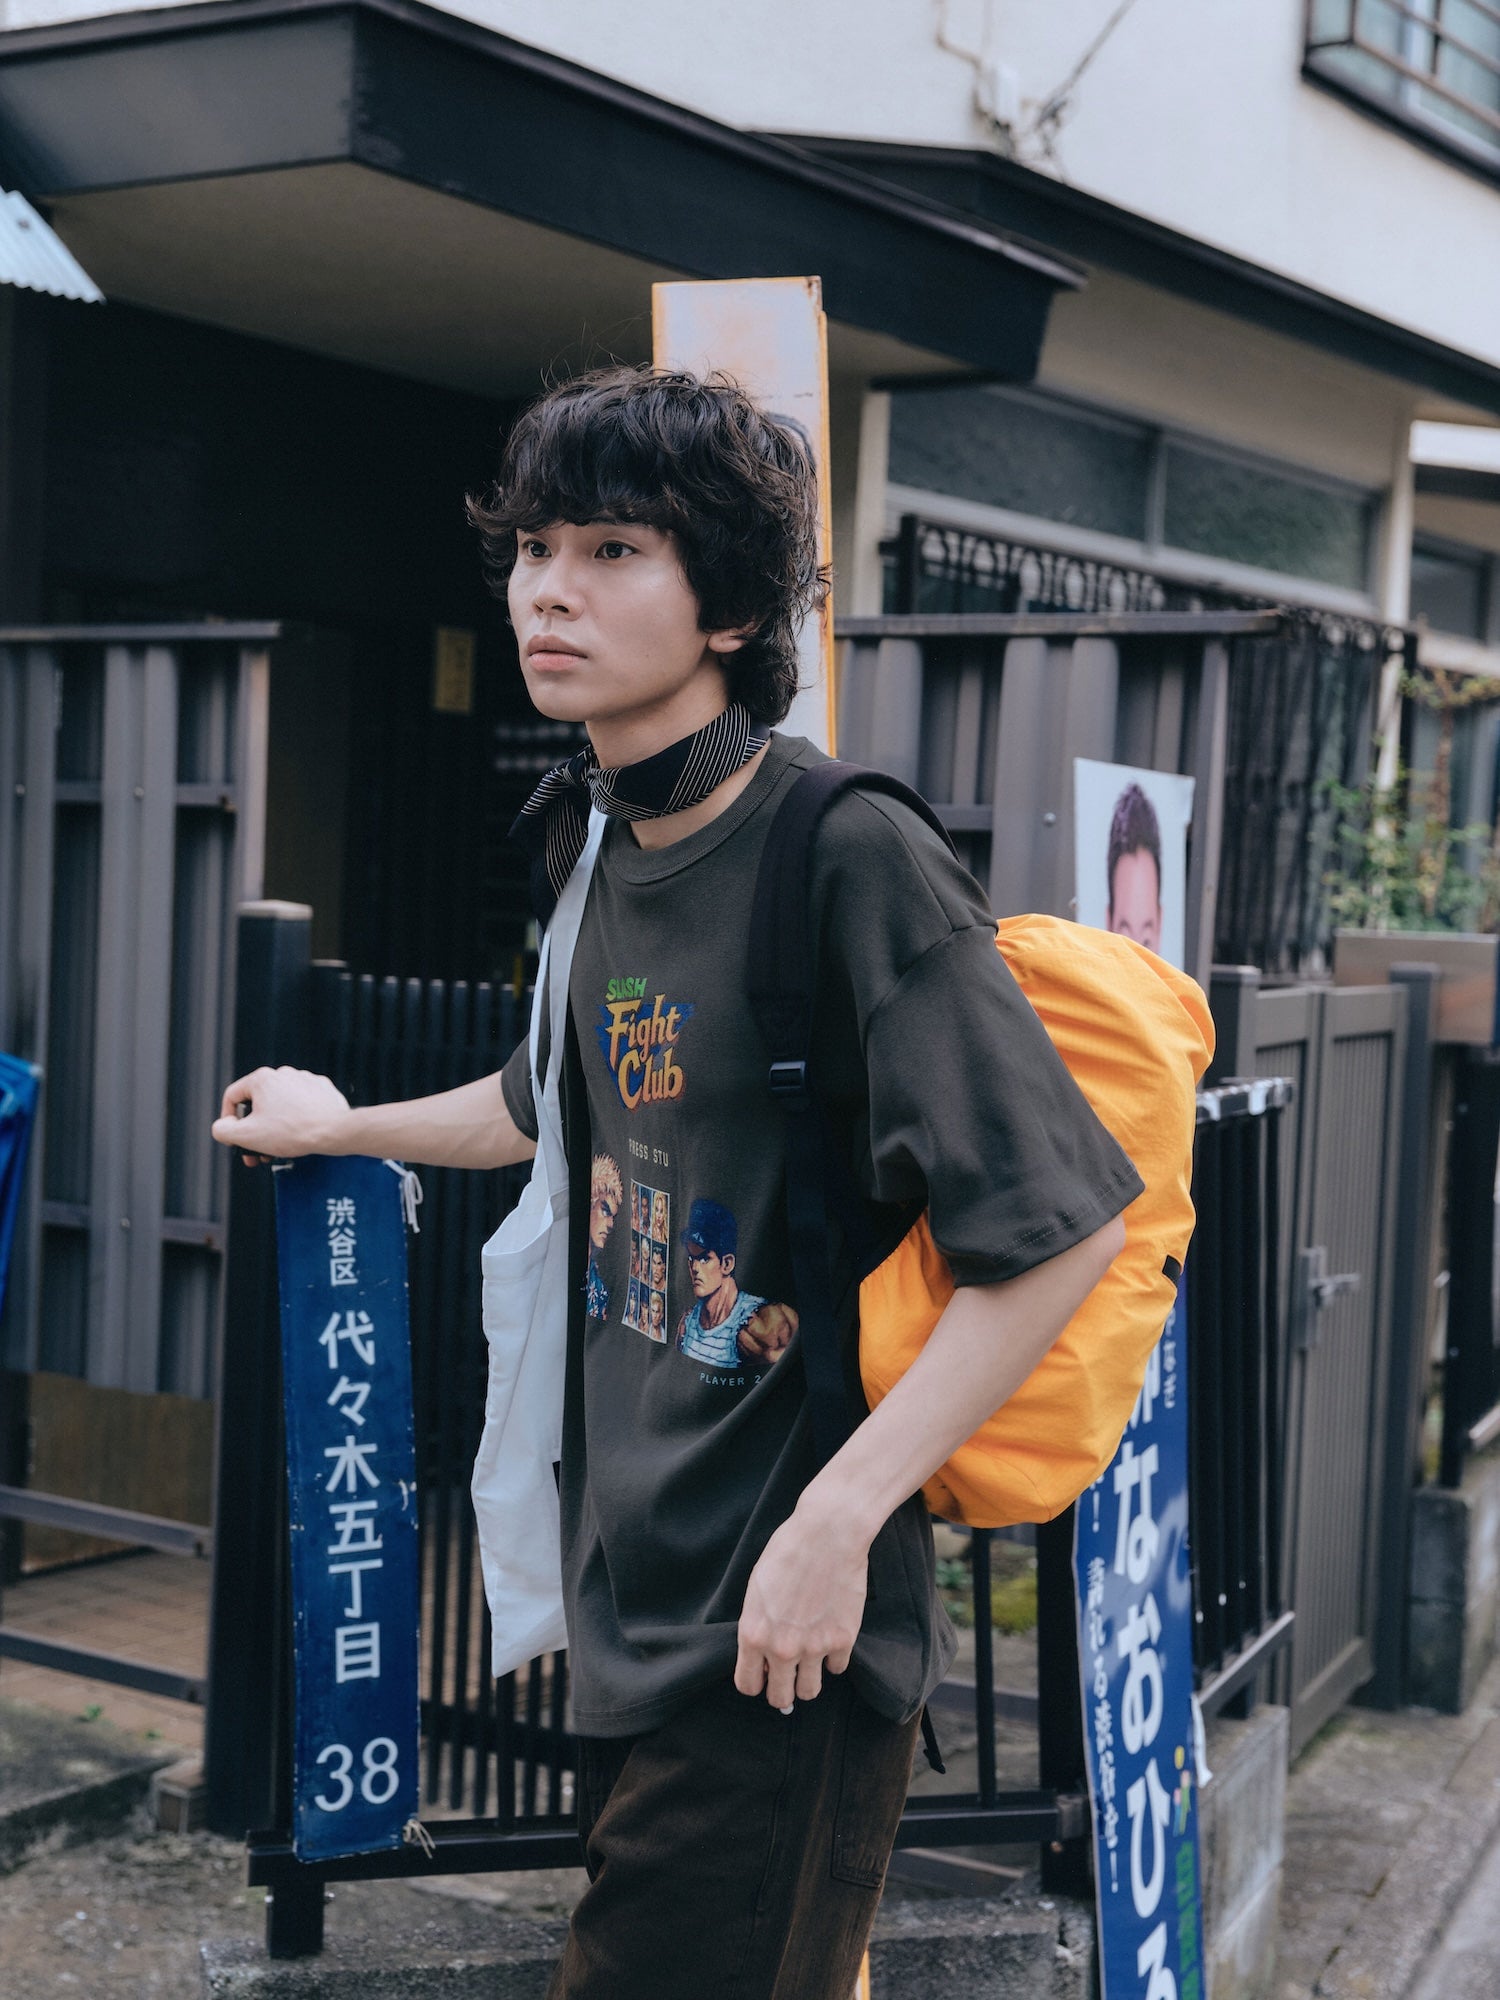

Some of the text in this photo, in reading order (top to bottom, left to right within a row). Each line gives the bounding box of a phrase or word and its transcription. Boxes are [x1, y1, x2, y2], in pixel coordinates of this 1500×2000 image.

[604, 993, 682, 1070] Fight
[617, 1046, 685, 1111] Club
[699, 1372, 745, 1387] PLAYER
[314, 1198, 400, 1812] 渋谷区 代々木五丁目 38
